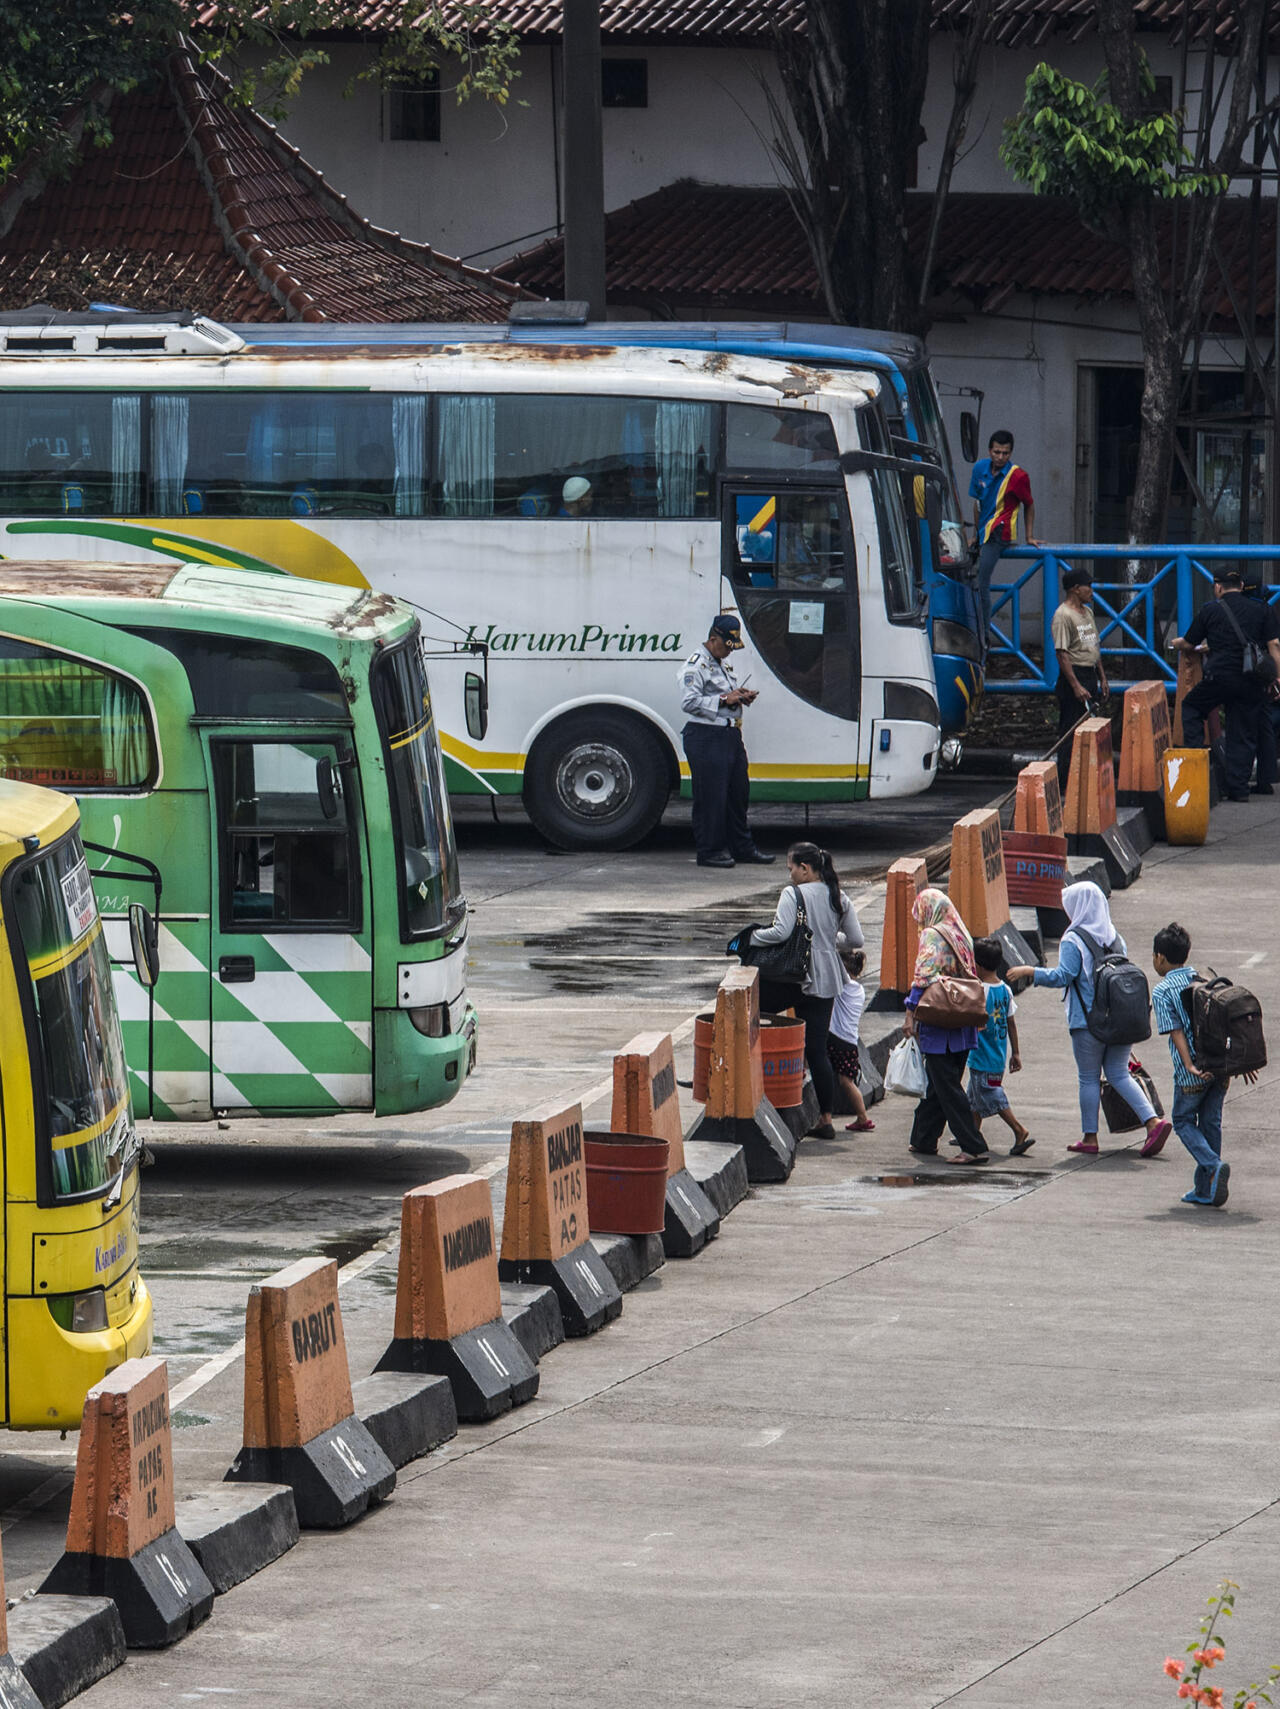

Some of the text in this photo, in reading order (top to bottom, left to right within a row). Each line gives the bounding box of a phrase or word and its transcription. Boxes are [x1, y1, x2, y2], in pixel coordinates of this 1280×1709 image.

[547, 1122, 582, 1173] BANJAR
[553, 1167, 582, 1215] PATAS
[292, 1302, 337, 1364] GARUT
[138, 1444, 162, 1490] PATAS
